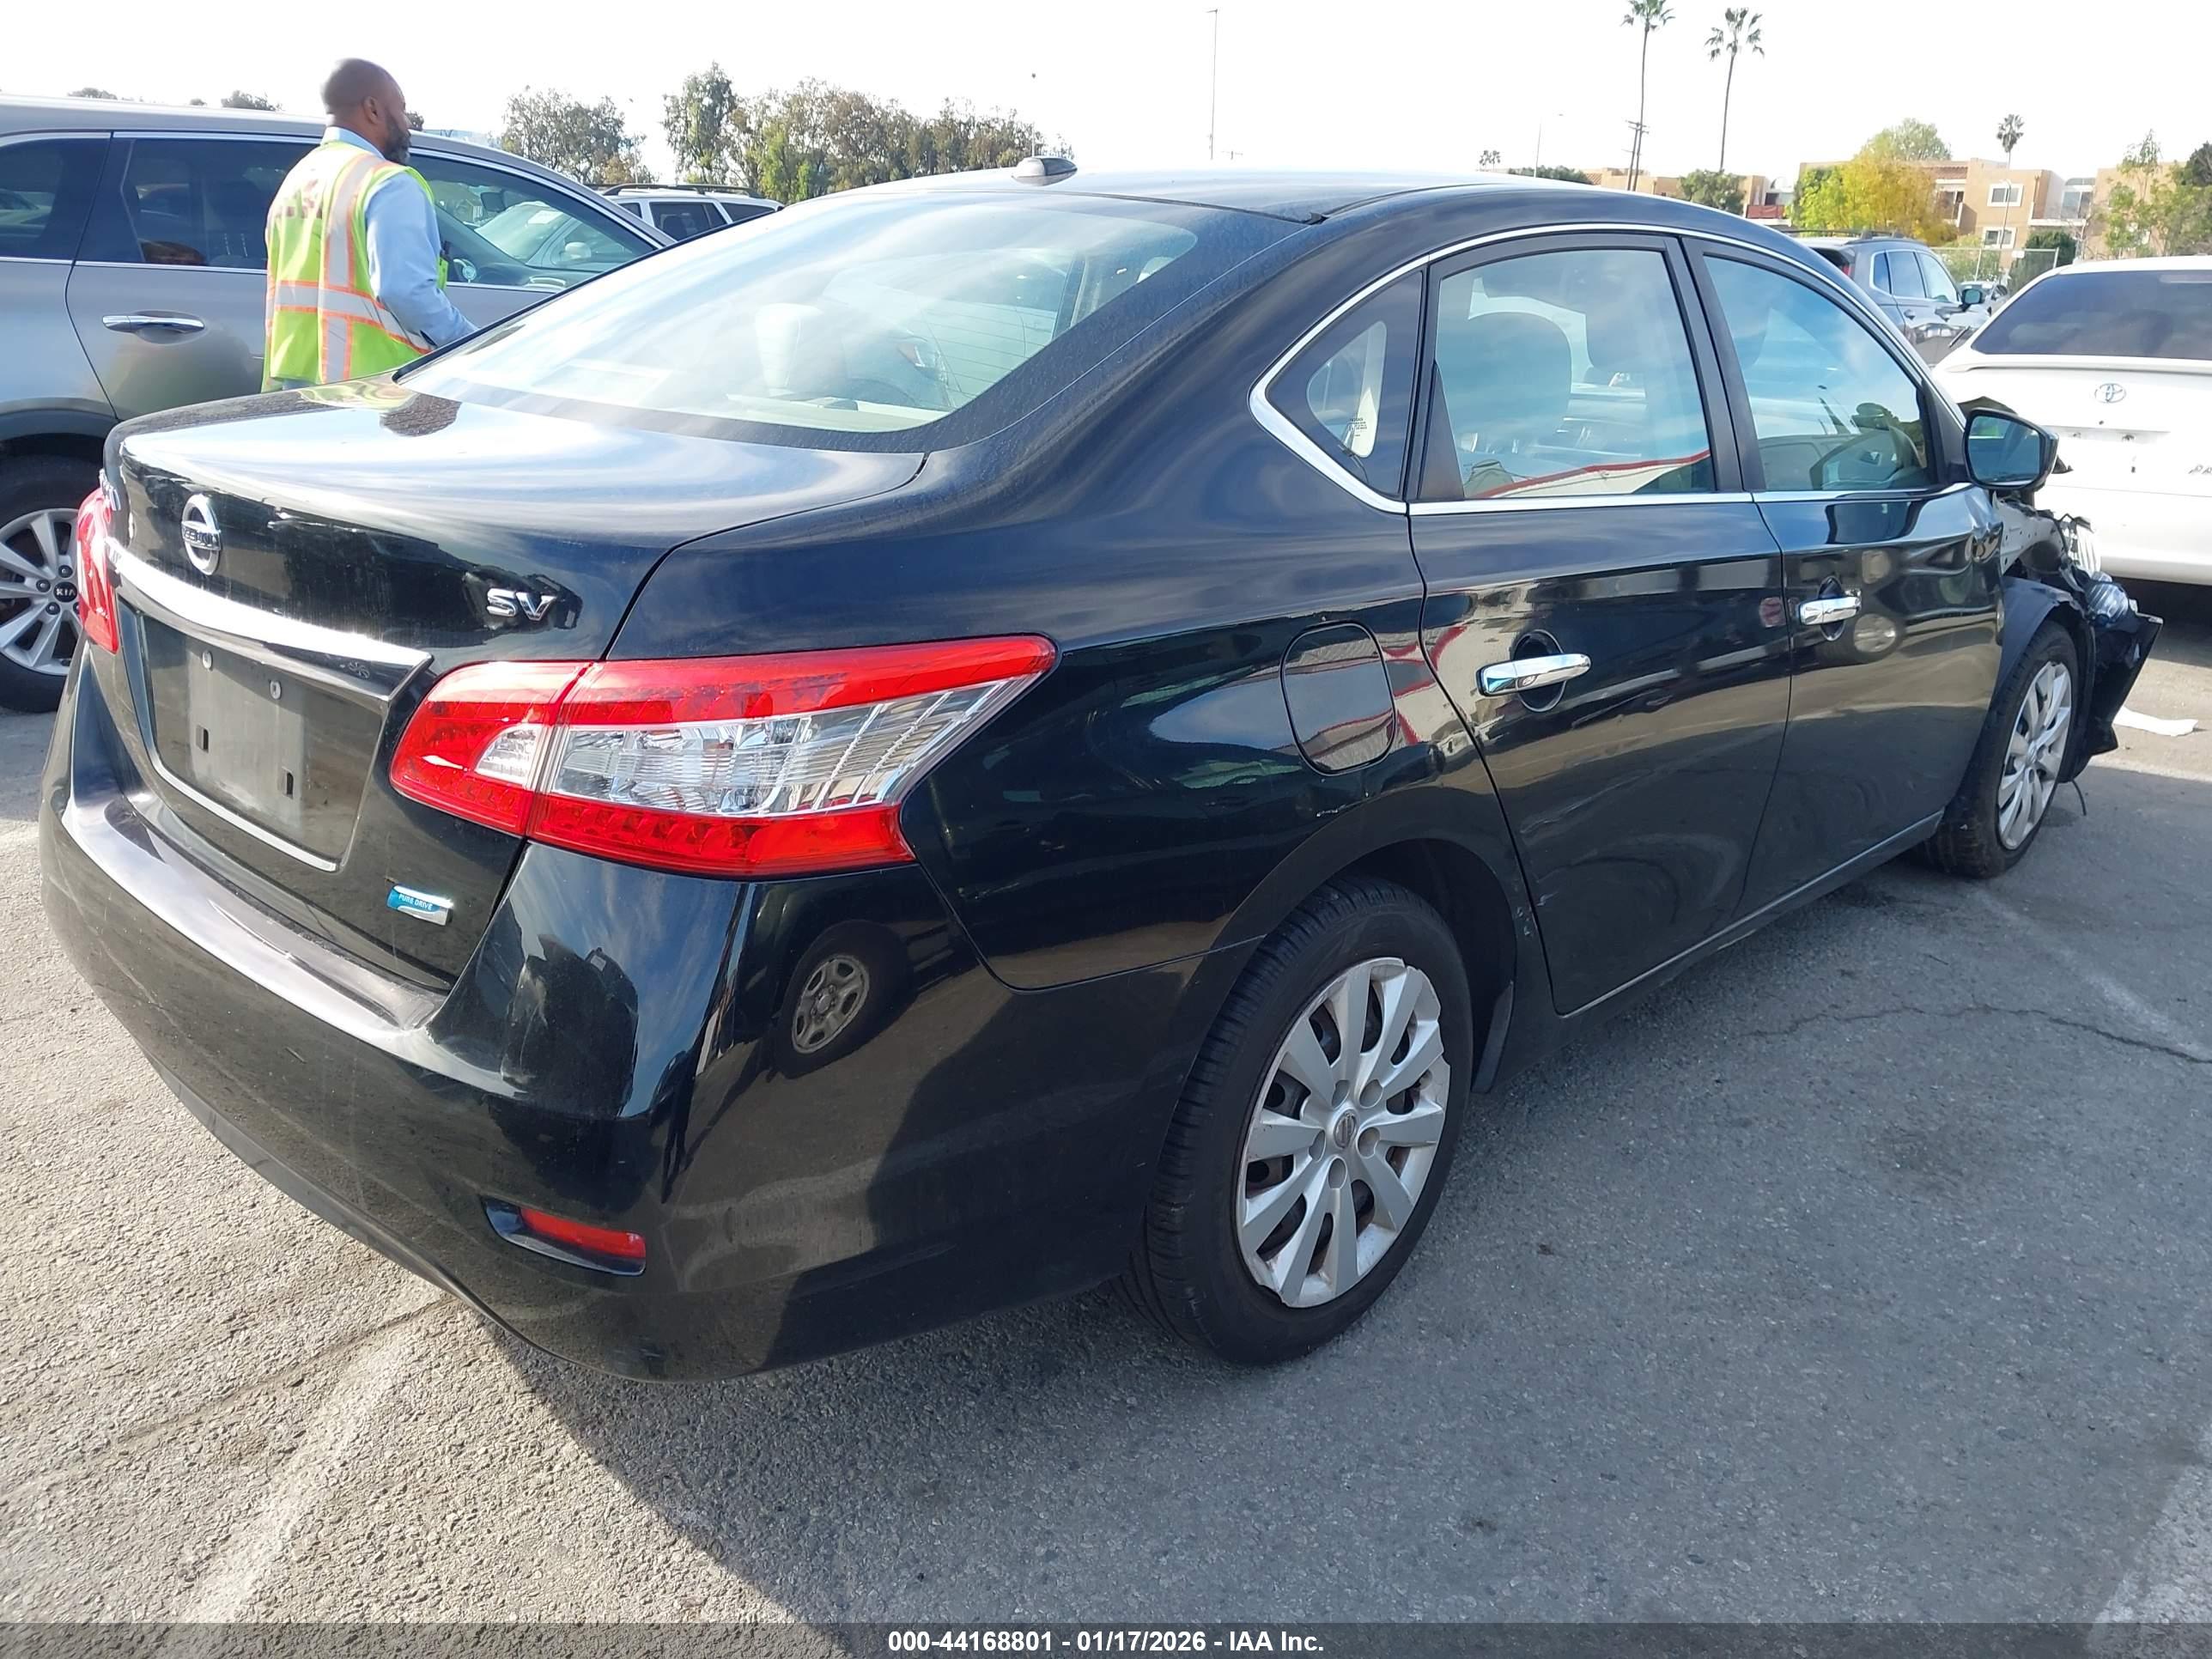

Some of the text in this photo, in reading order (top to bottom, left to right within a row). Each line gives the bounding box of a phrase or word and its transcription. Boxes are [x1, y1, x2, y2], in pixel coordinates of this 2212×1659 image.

[56, 587, 76, 596] KIA
[486, 587, 556, 621] SV
[398, 893, 434, 911] PURE DRIVE
